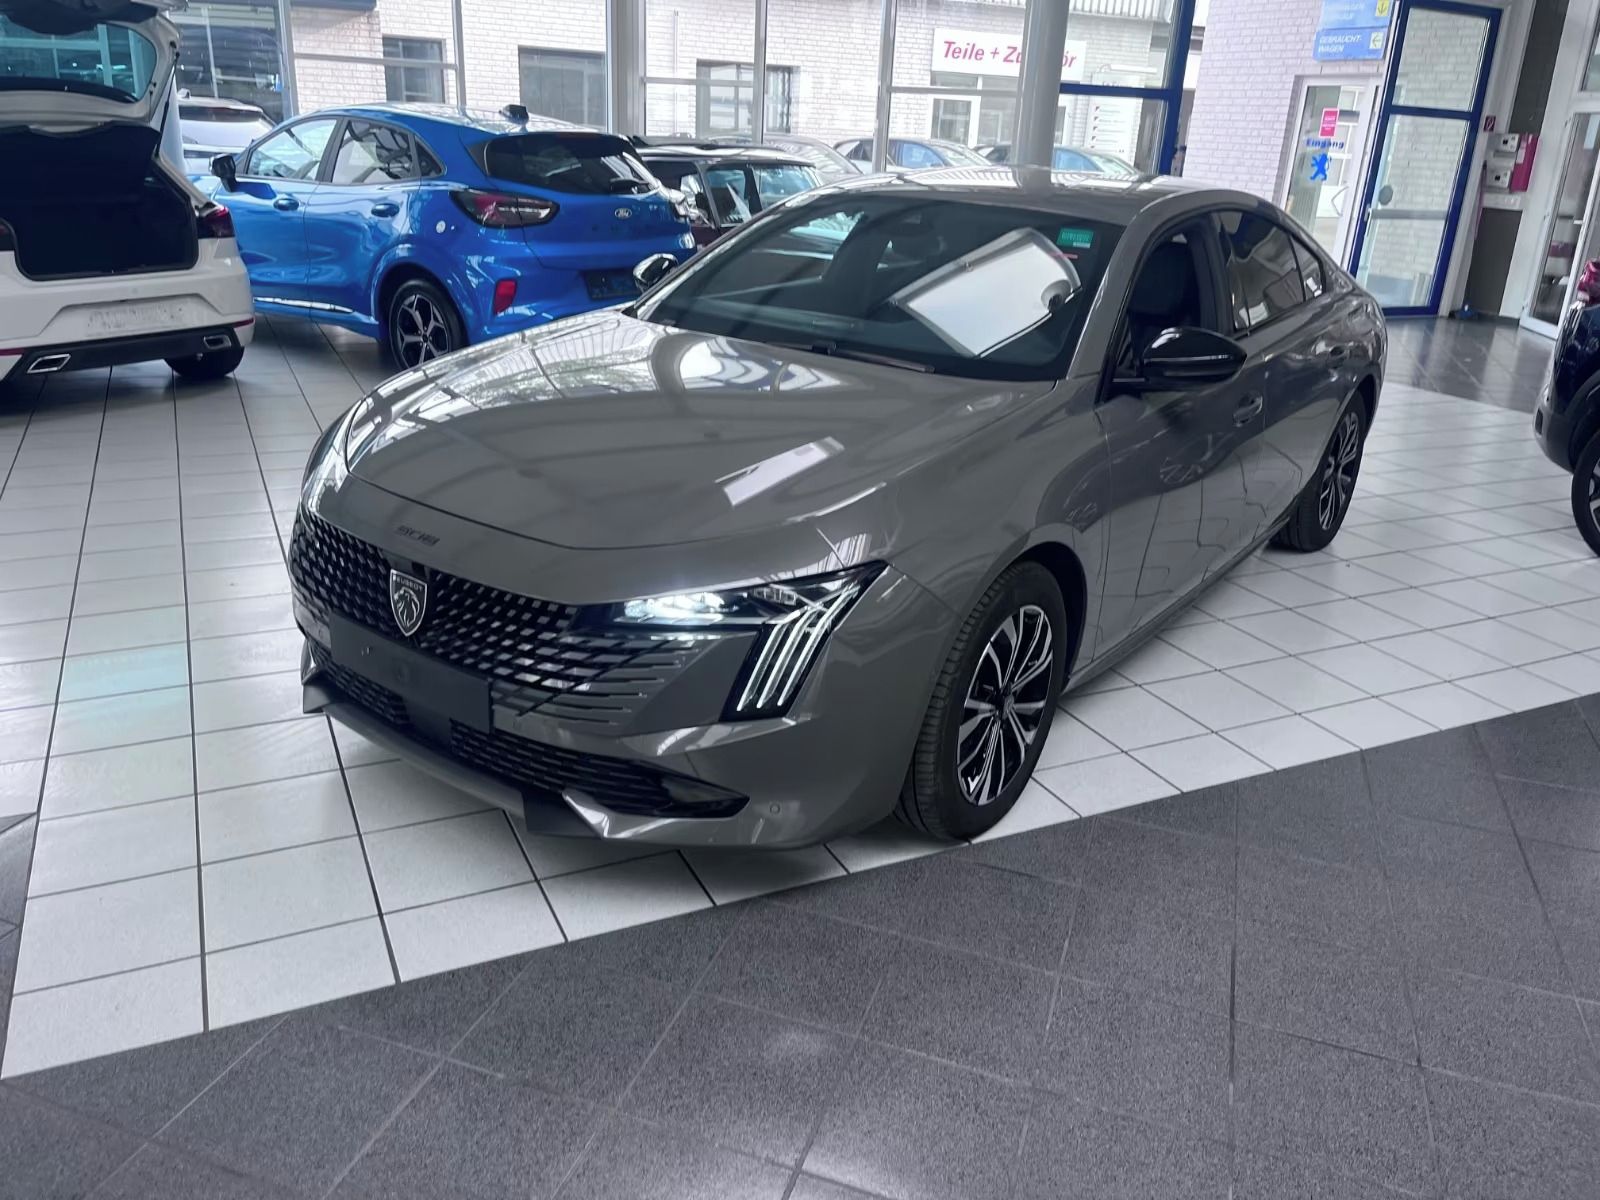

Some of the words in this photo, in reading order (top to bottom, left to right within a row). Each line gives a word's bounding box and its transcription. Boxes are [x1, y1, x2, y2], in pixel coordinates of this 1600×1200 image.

[944, 41, 985, 61] Teile
[990, 47, 1000, 60] +
[1306, 139, 1345, 149] Eingang
